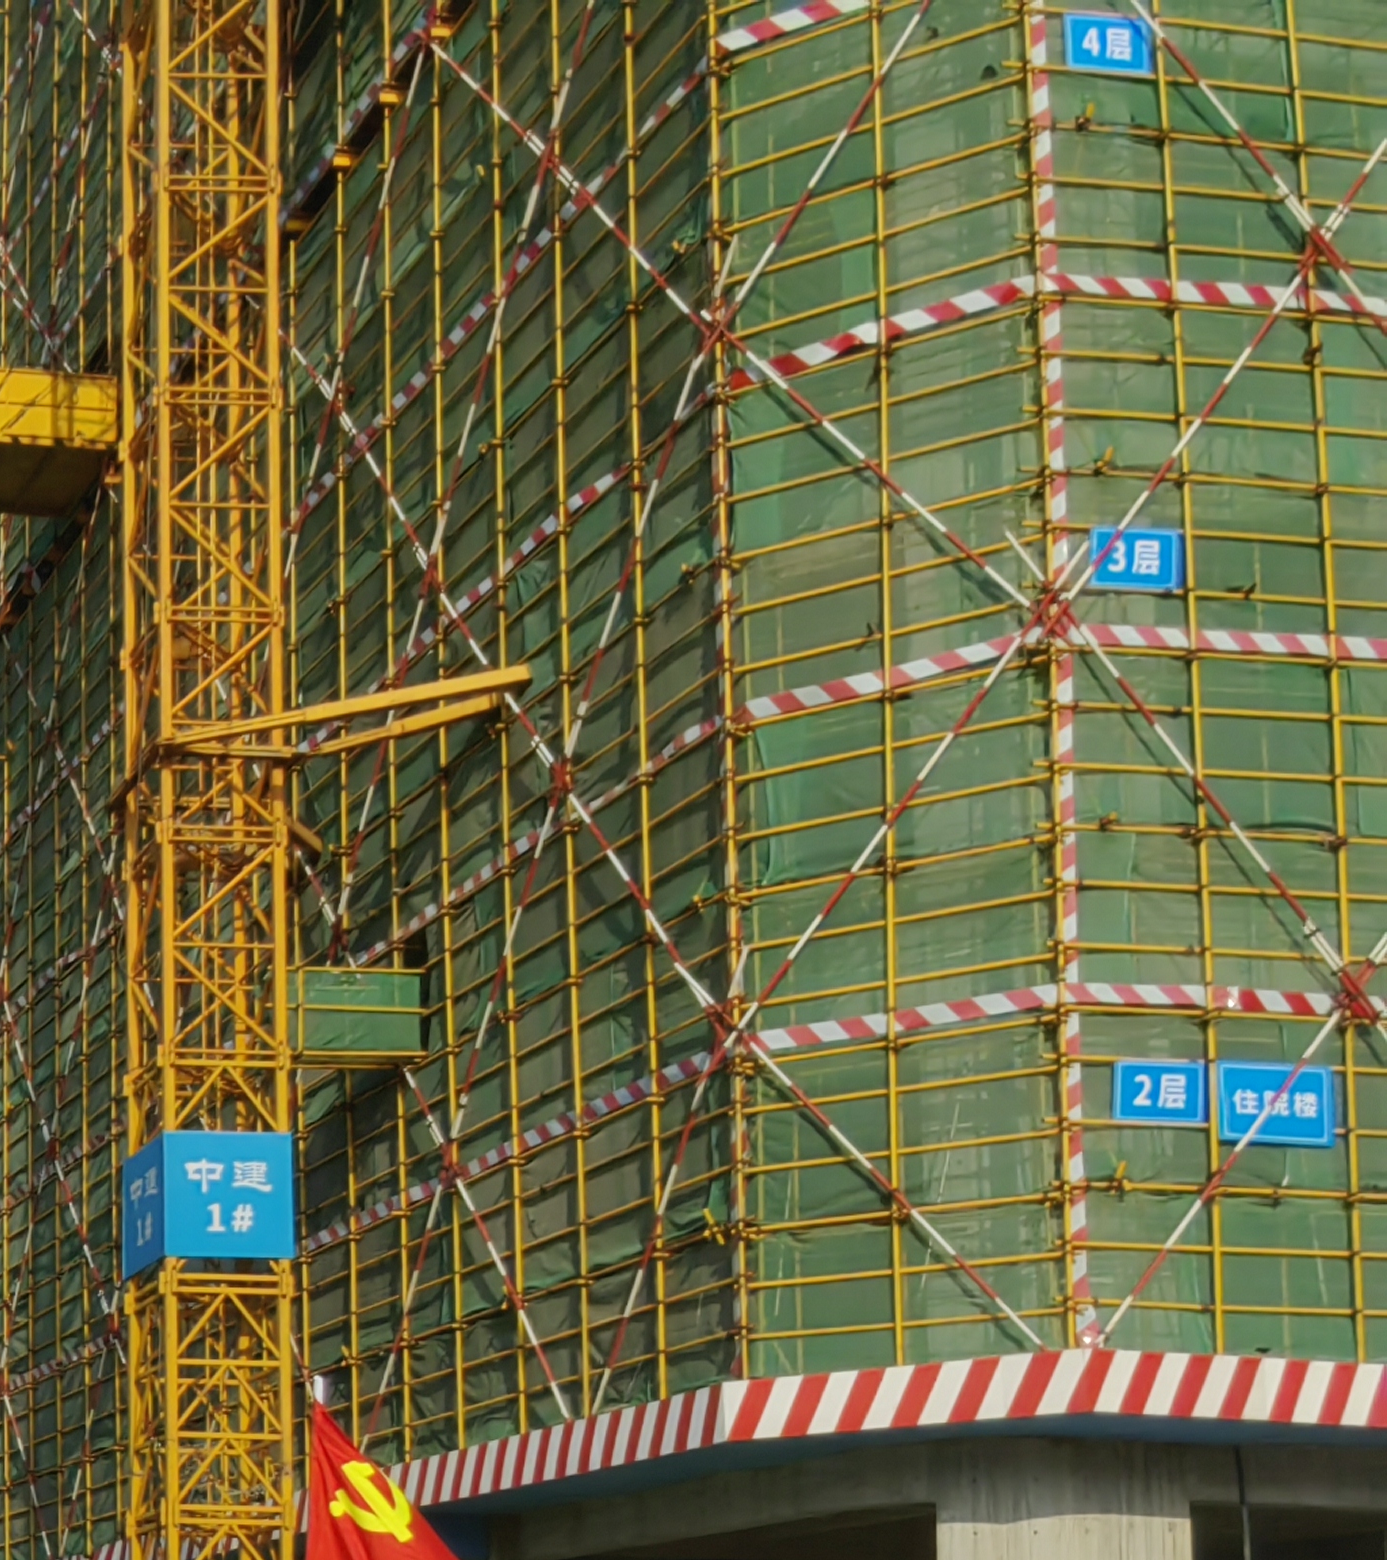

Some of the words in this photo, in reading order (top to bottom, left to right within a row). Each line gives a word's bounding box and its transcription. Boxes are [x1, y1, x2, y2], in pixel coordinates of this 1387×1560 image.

[1082, 27, 1133, 61] 4层
[1107, 540, 1160, 575] 3层
[1132, 1074, 1187, 1109] 2层
[1232, 1089, 1319, 1118] 住院楼
[184, 1158, 273, 1194] 中建
[206, 1203, 254, 1232] 1#
